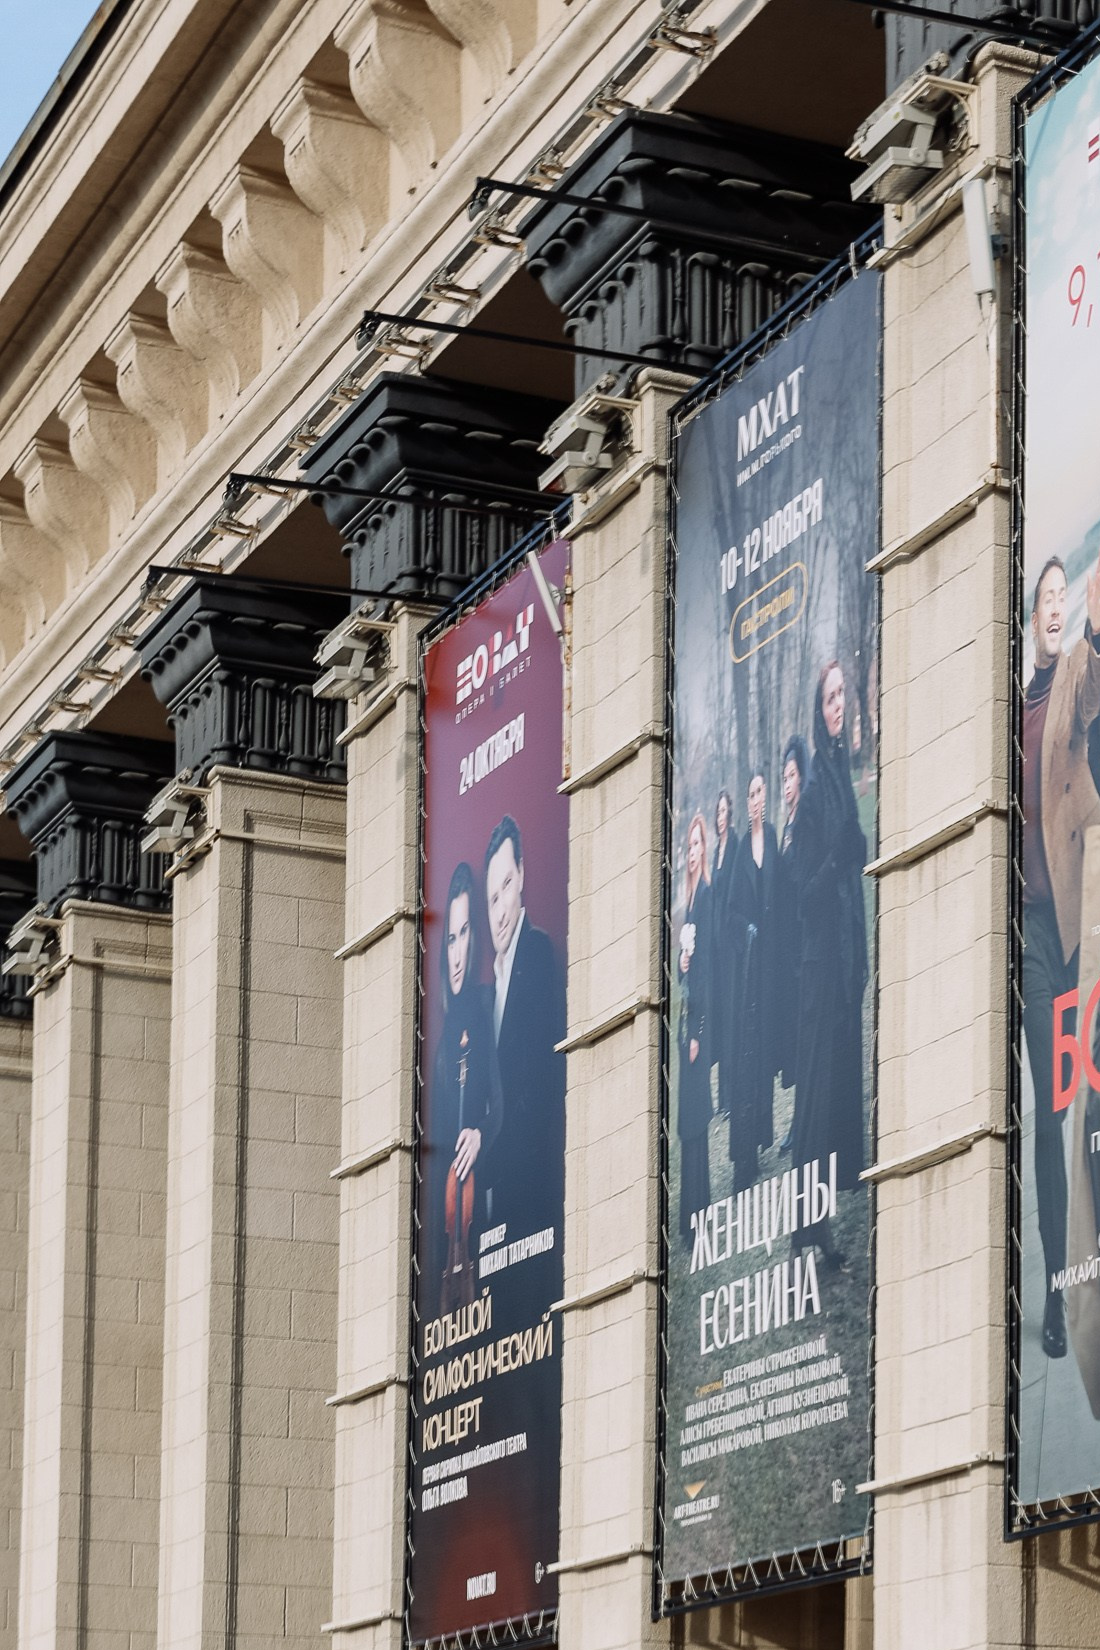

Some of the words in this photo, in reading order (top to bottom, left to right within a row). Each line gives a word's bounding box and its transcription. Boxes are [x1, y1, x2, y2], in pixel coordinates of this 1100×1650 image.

[737, 364, 804, 463] МХАТ
[720, 530, 761, 595] 10-12
[762, 477, 823, 562] НОЯБРЯ
[458, 751, 474, 796] 24
[474, 712, 526, 783] ОКТЯБРЯ
[690, 1151, 837, 1275] ЖЕНЩИНЫ
[424, 1287, 492, 1358] БОЛЬШОЙ
[700, 1251, 821, 1356] ЕСЕНИНА
[423, 1312, 553, 1405] СИМФОНИЧЕСКИЙ
[723, 1356, 765, 1386] ЕКАТЕРИНЫ
[750, 1373, 794, 1402] ЕКАТЕРИНЫ
[422, 1396, 483, 1453] КОНЦЕРТ
